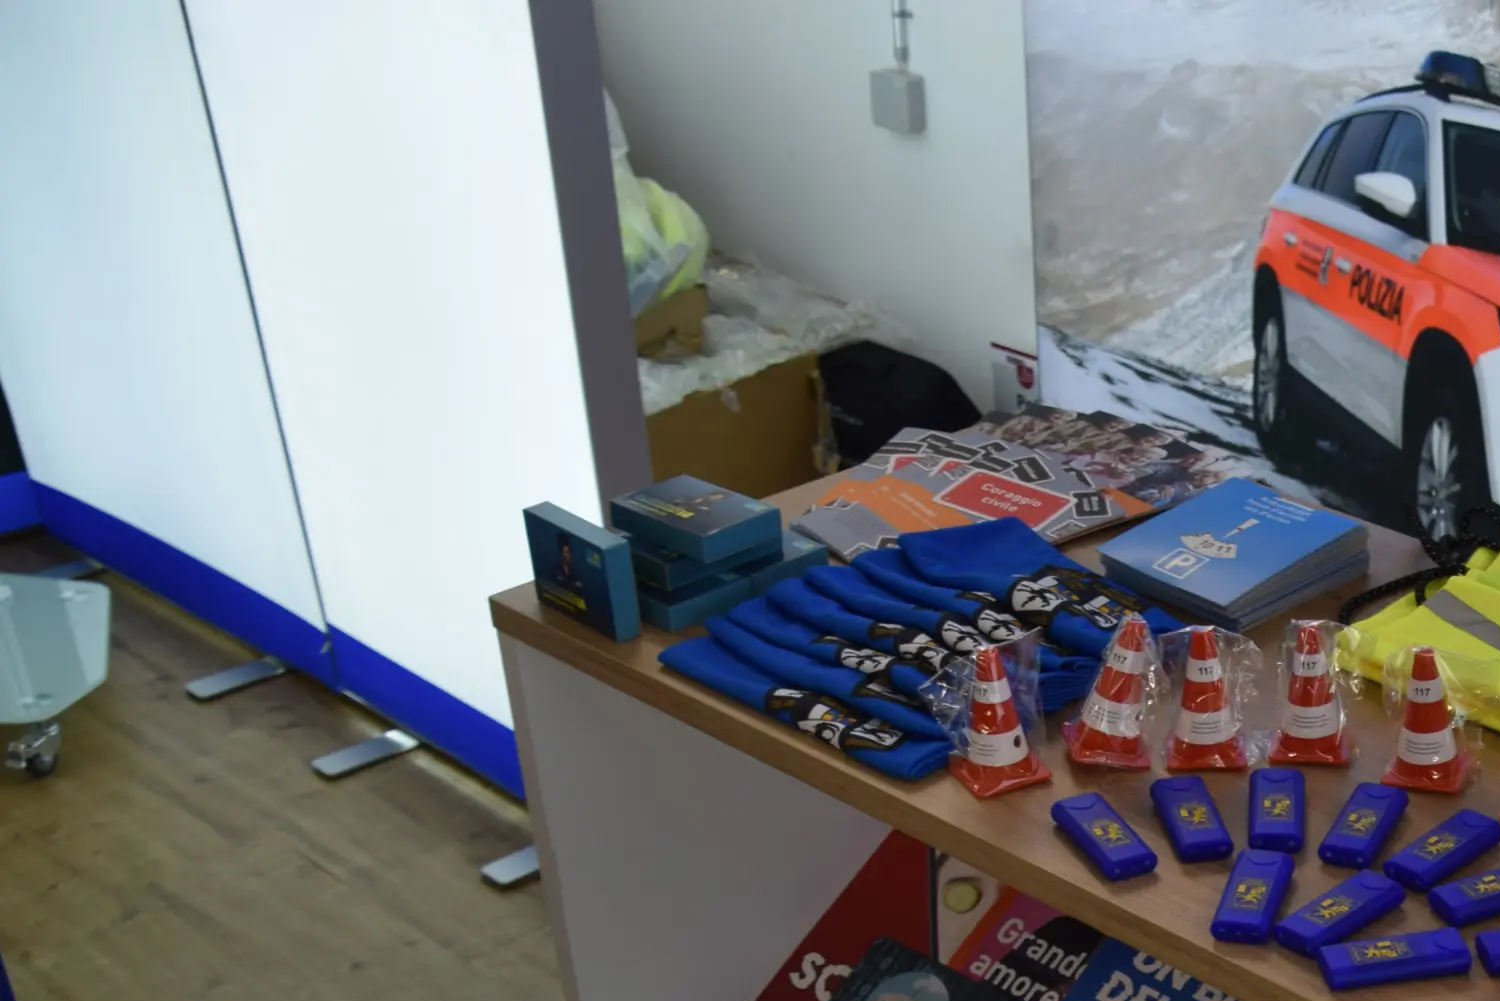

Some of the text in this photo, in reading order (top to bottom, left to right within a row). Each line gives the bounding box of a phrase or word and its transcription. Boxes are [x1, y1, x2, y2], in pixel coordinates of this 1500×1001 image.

[1348, 264, 1405, 327] POLIZIA
[981, 483, 1042, 508] Coraggio
[981, 496, 1019, 513] civile
[1200, 539, 1232, 555] 10 11
[1165, 554, 1197, 570] P
[1112, 652, 1128, 664] 117
[1301, 661, 1316, 670] 117
[1414, 688, 1430, 696] 117
